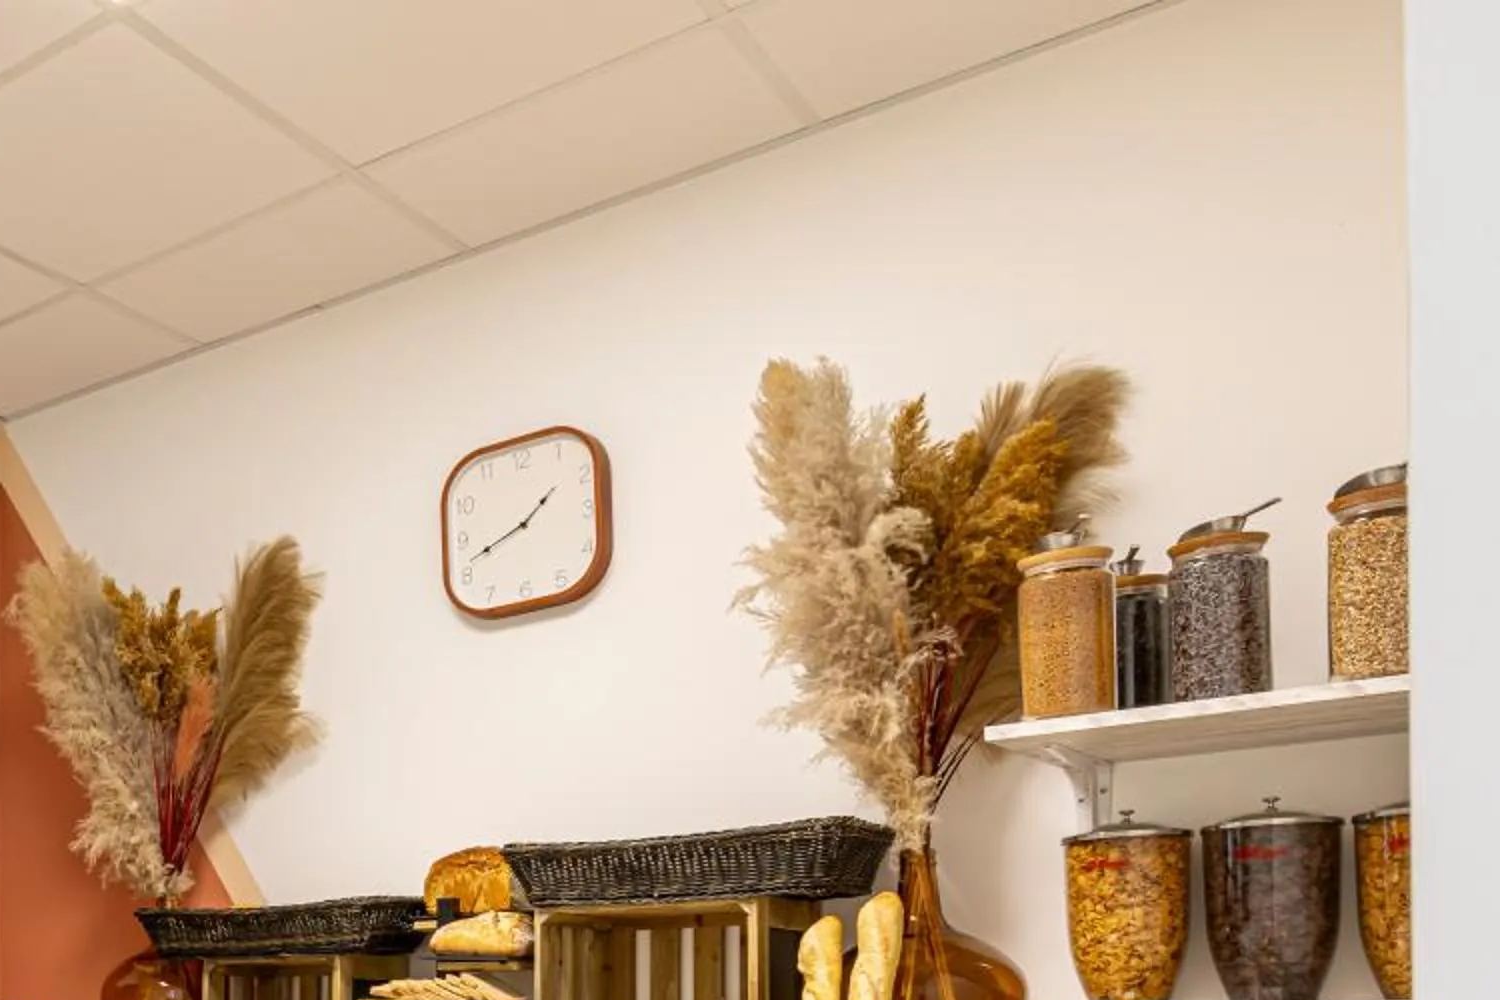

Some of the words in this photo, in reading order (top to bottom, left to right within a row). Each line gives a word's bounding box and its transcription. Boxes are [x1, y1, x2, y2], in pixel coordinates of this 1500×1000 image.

[513, 450, 531, 471] 12
[480, 464, 495, 480] 11
[579, 466, 591, 484] 2
[456, 495, 475, 516] 10
[583, 499, 593, 518] 3
[458, 532, 468, 547] 9
[581, 538, 593, 554] 4
[461, 567, 473, 586] 8
[554, 570, 568, 588] 5
[485, 587, 497, 604] 7
[519, 580, 533, 597] 6
